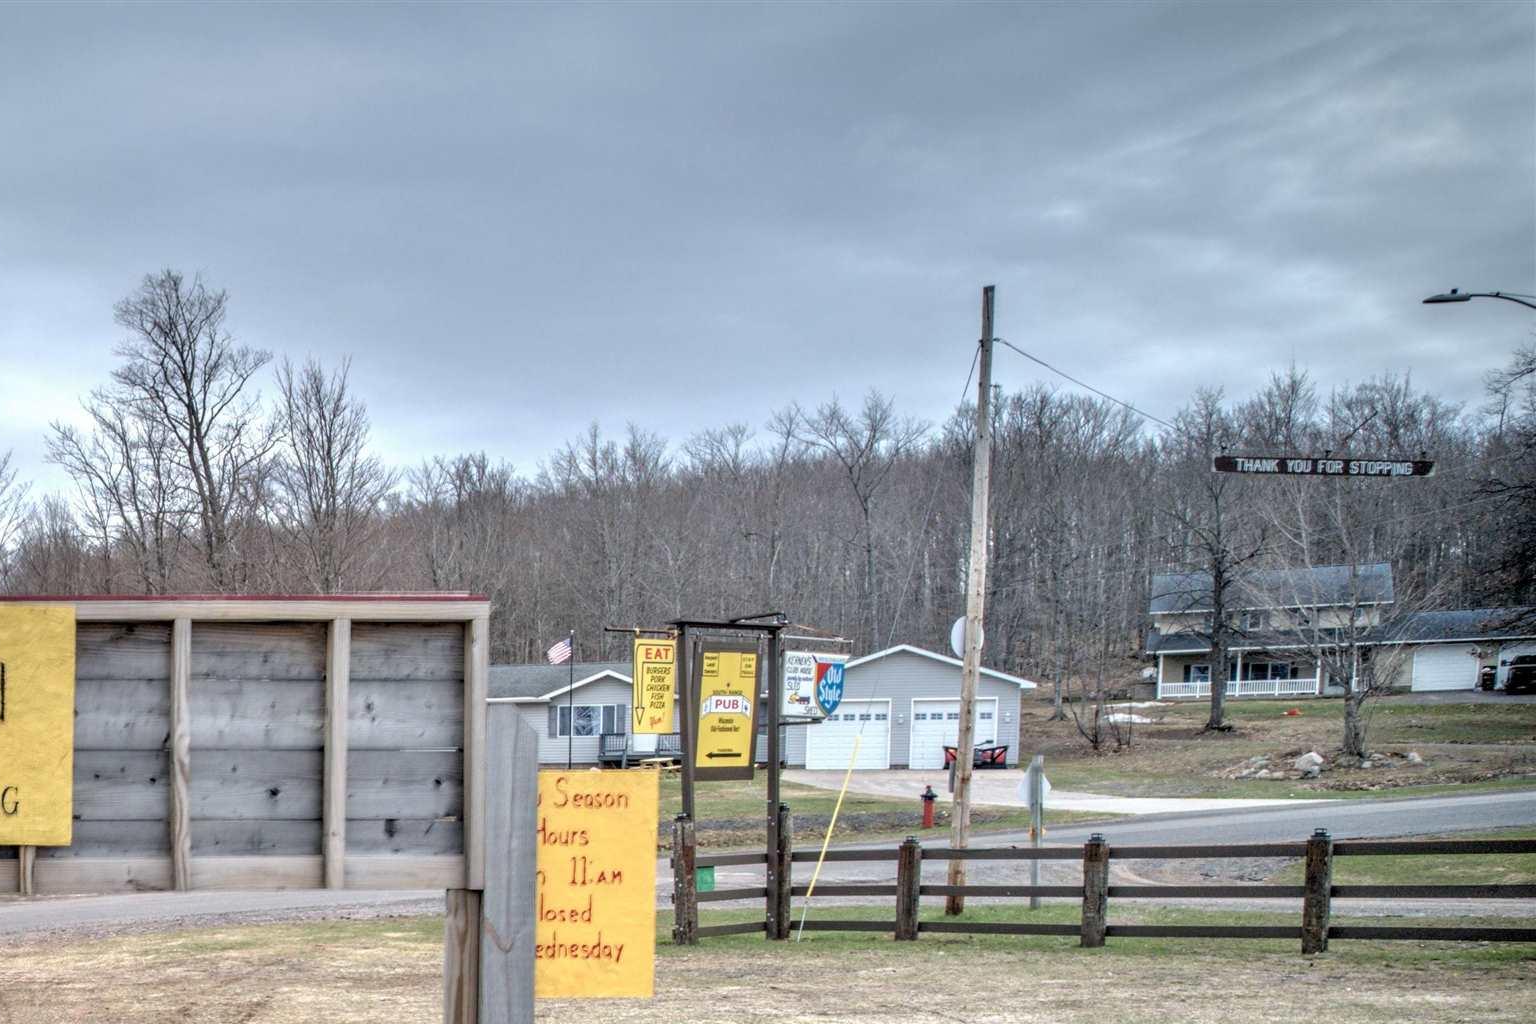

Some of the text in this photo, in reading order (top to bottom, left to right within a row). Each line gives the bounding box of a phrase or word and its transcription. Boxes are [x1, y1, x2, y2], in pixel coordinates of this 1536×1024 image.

[1234, 458, 1414, 476] THANK YOU FOR STOPPING
[645, 647, 671, 660] EAT
[646, 667, 672, 675] BURGERS
[827, 665, 843, 686] Old
[650, 676, 666, 684] PORK
[646, 684, 670, 693] CHICKEN
[819, 678, 842, 710] Style
[650, 693, 665, 701] FISH
[649, 702, 666, 710] PIZZA
[715, 699, 740, 710] PUB
[554, 777, 629, 808] Season
[540, 893, 592, 922] losed
[535, 931, 624, 964] ednesday
